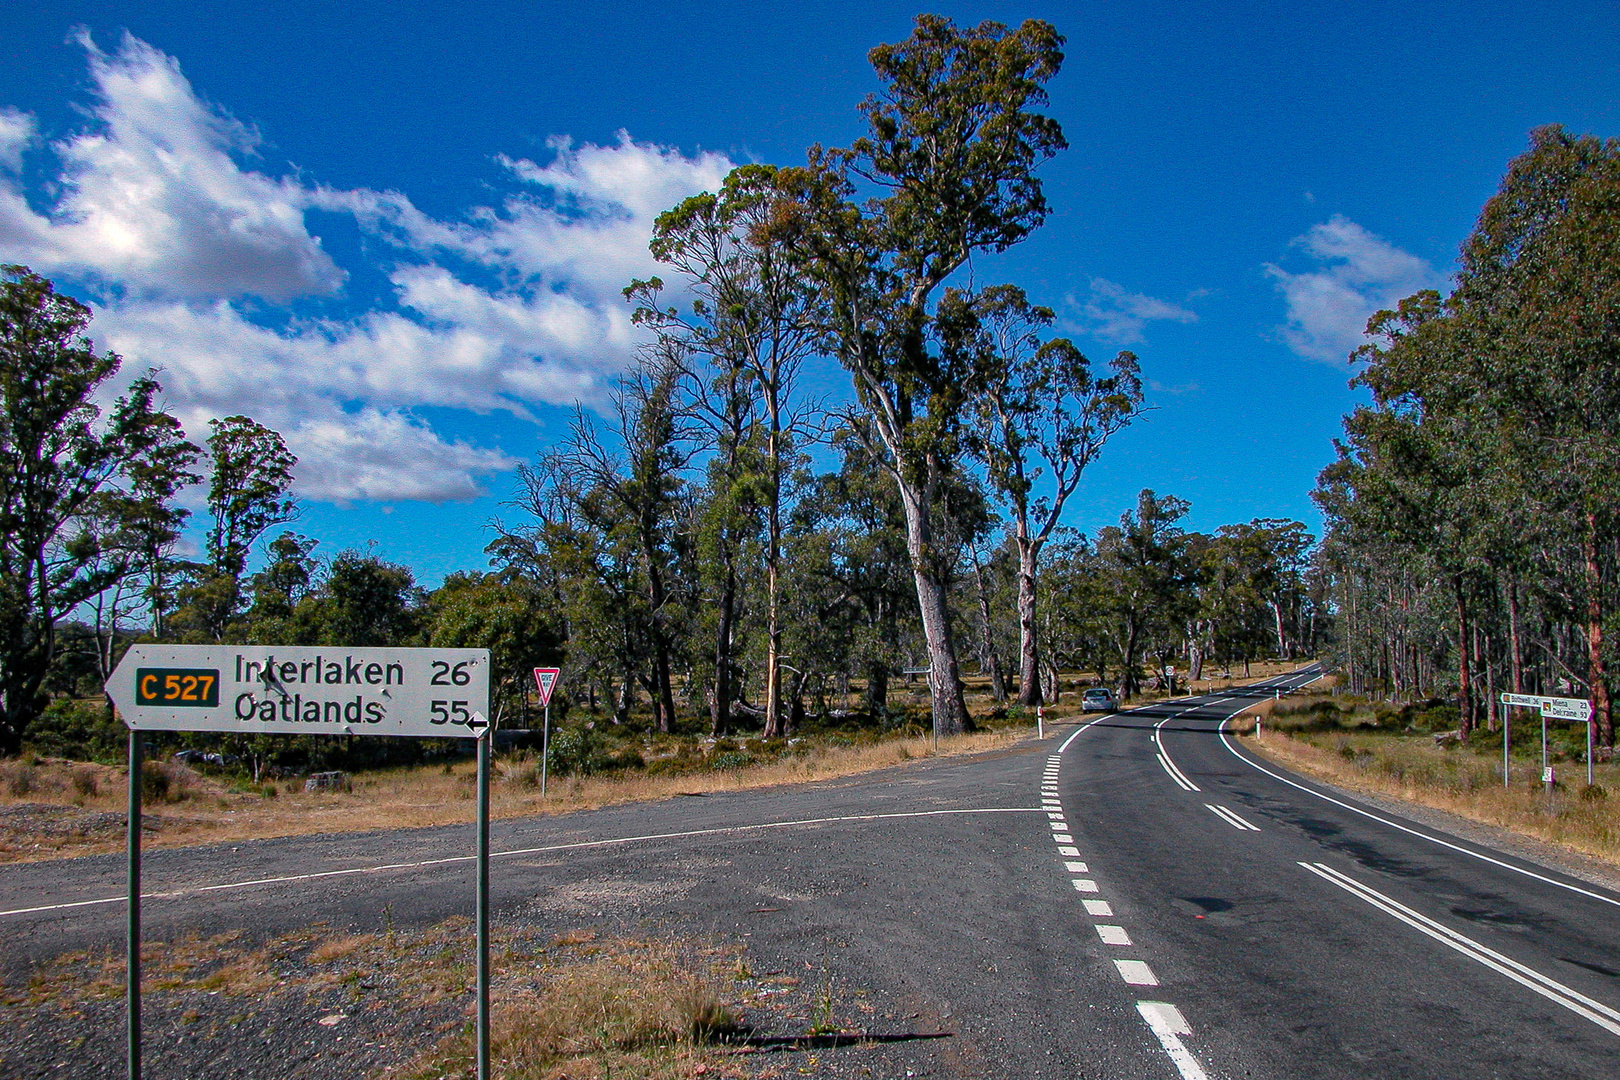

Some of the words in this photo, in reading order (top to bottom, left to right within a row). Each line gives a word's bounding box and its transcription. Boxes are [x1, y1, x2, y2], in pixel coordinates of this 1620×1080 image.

[235, 654, 403, 685] Interlaken
[430, 660, 471, 686] 26
[140, 674, 158, 700] C
[163, 674, 215, 700] 527
[234, 692, 383, 724] Oatlands
[429, 700, 470, 725] 55
[1552, 698, 1568, 707] Miena
[1552, 707, 1577, 717] Delraine
[1580, 711, 1587, 719] 93
